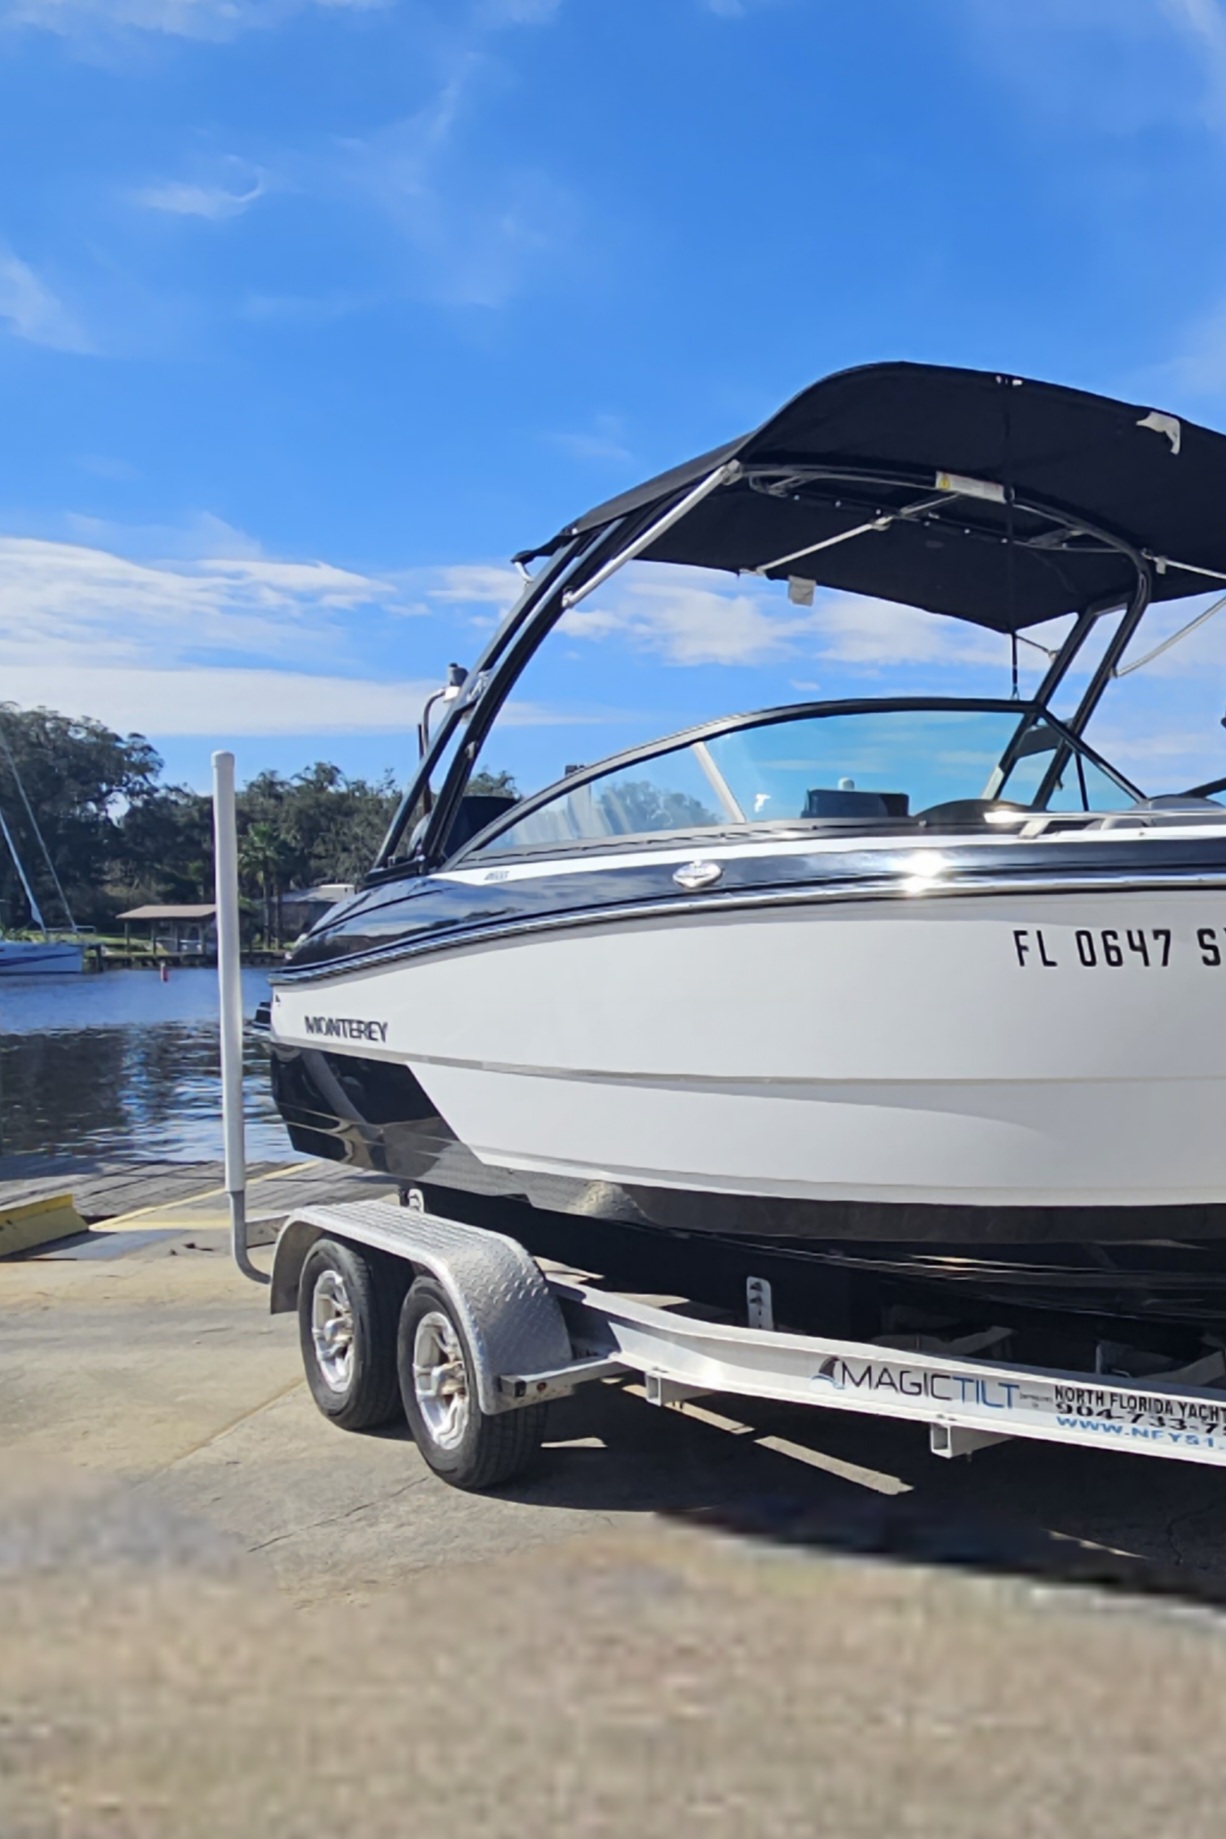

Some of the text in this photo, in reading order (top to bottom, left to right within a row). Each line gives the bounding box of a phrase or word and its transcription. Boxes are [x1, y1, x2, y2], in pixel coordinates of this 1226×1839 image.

[1013, 930, 1058, 967] FL
[1075, 929, 1171, 967] 0647
[304, 1015, 389, 1043] MONTEREY
[842, 1361, 1020, 1409] MAGICTILT
[1054, 1384, 1105, 1407] NORTH
[1110, 1392, 1173, 1415] FLORIDA
